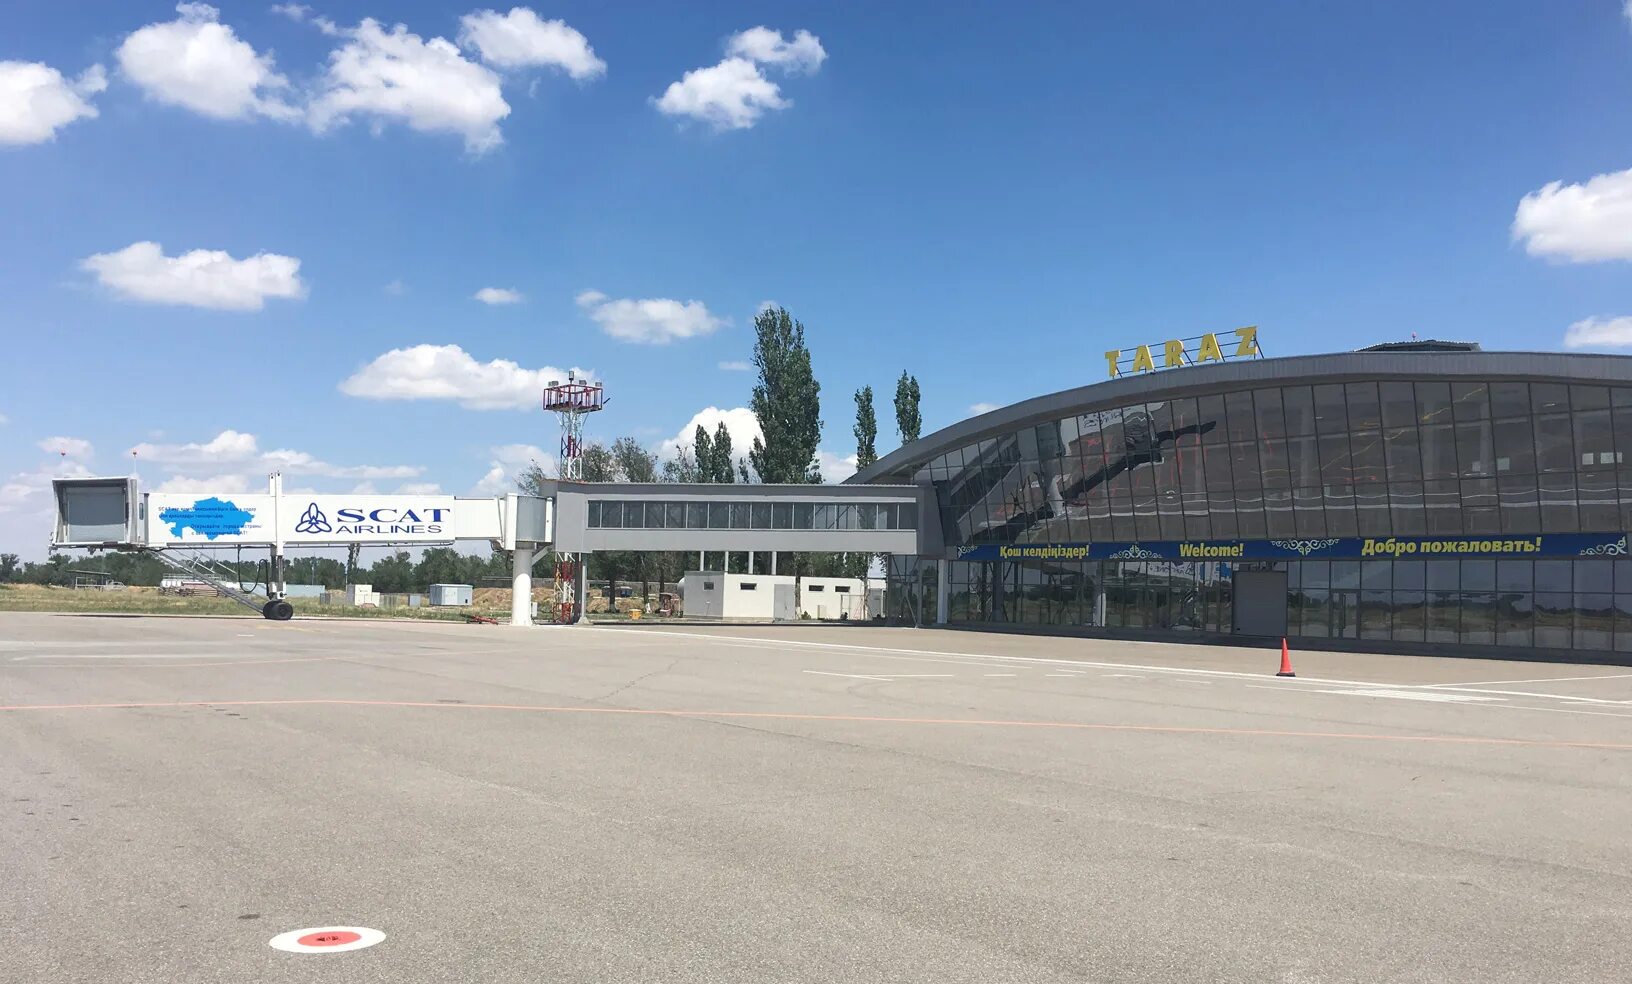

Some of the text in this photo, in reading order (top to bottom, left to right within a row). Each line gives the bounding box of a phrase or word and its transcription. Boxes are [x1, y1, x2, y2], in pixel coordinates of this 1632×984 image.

[1105, 326, 1258, 377] TARAZ
[337, 508, 451, 523] SCAT
[336, 525, 442, 534] AIRLINES
[1000, 544, 1089, 559] Қош келдіңіздер!
[1180, 543, 1244, 557] Welcome!
[1361, 537, 1542, 557] Добро пожаловать!
